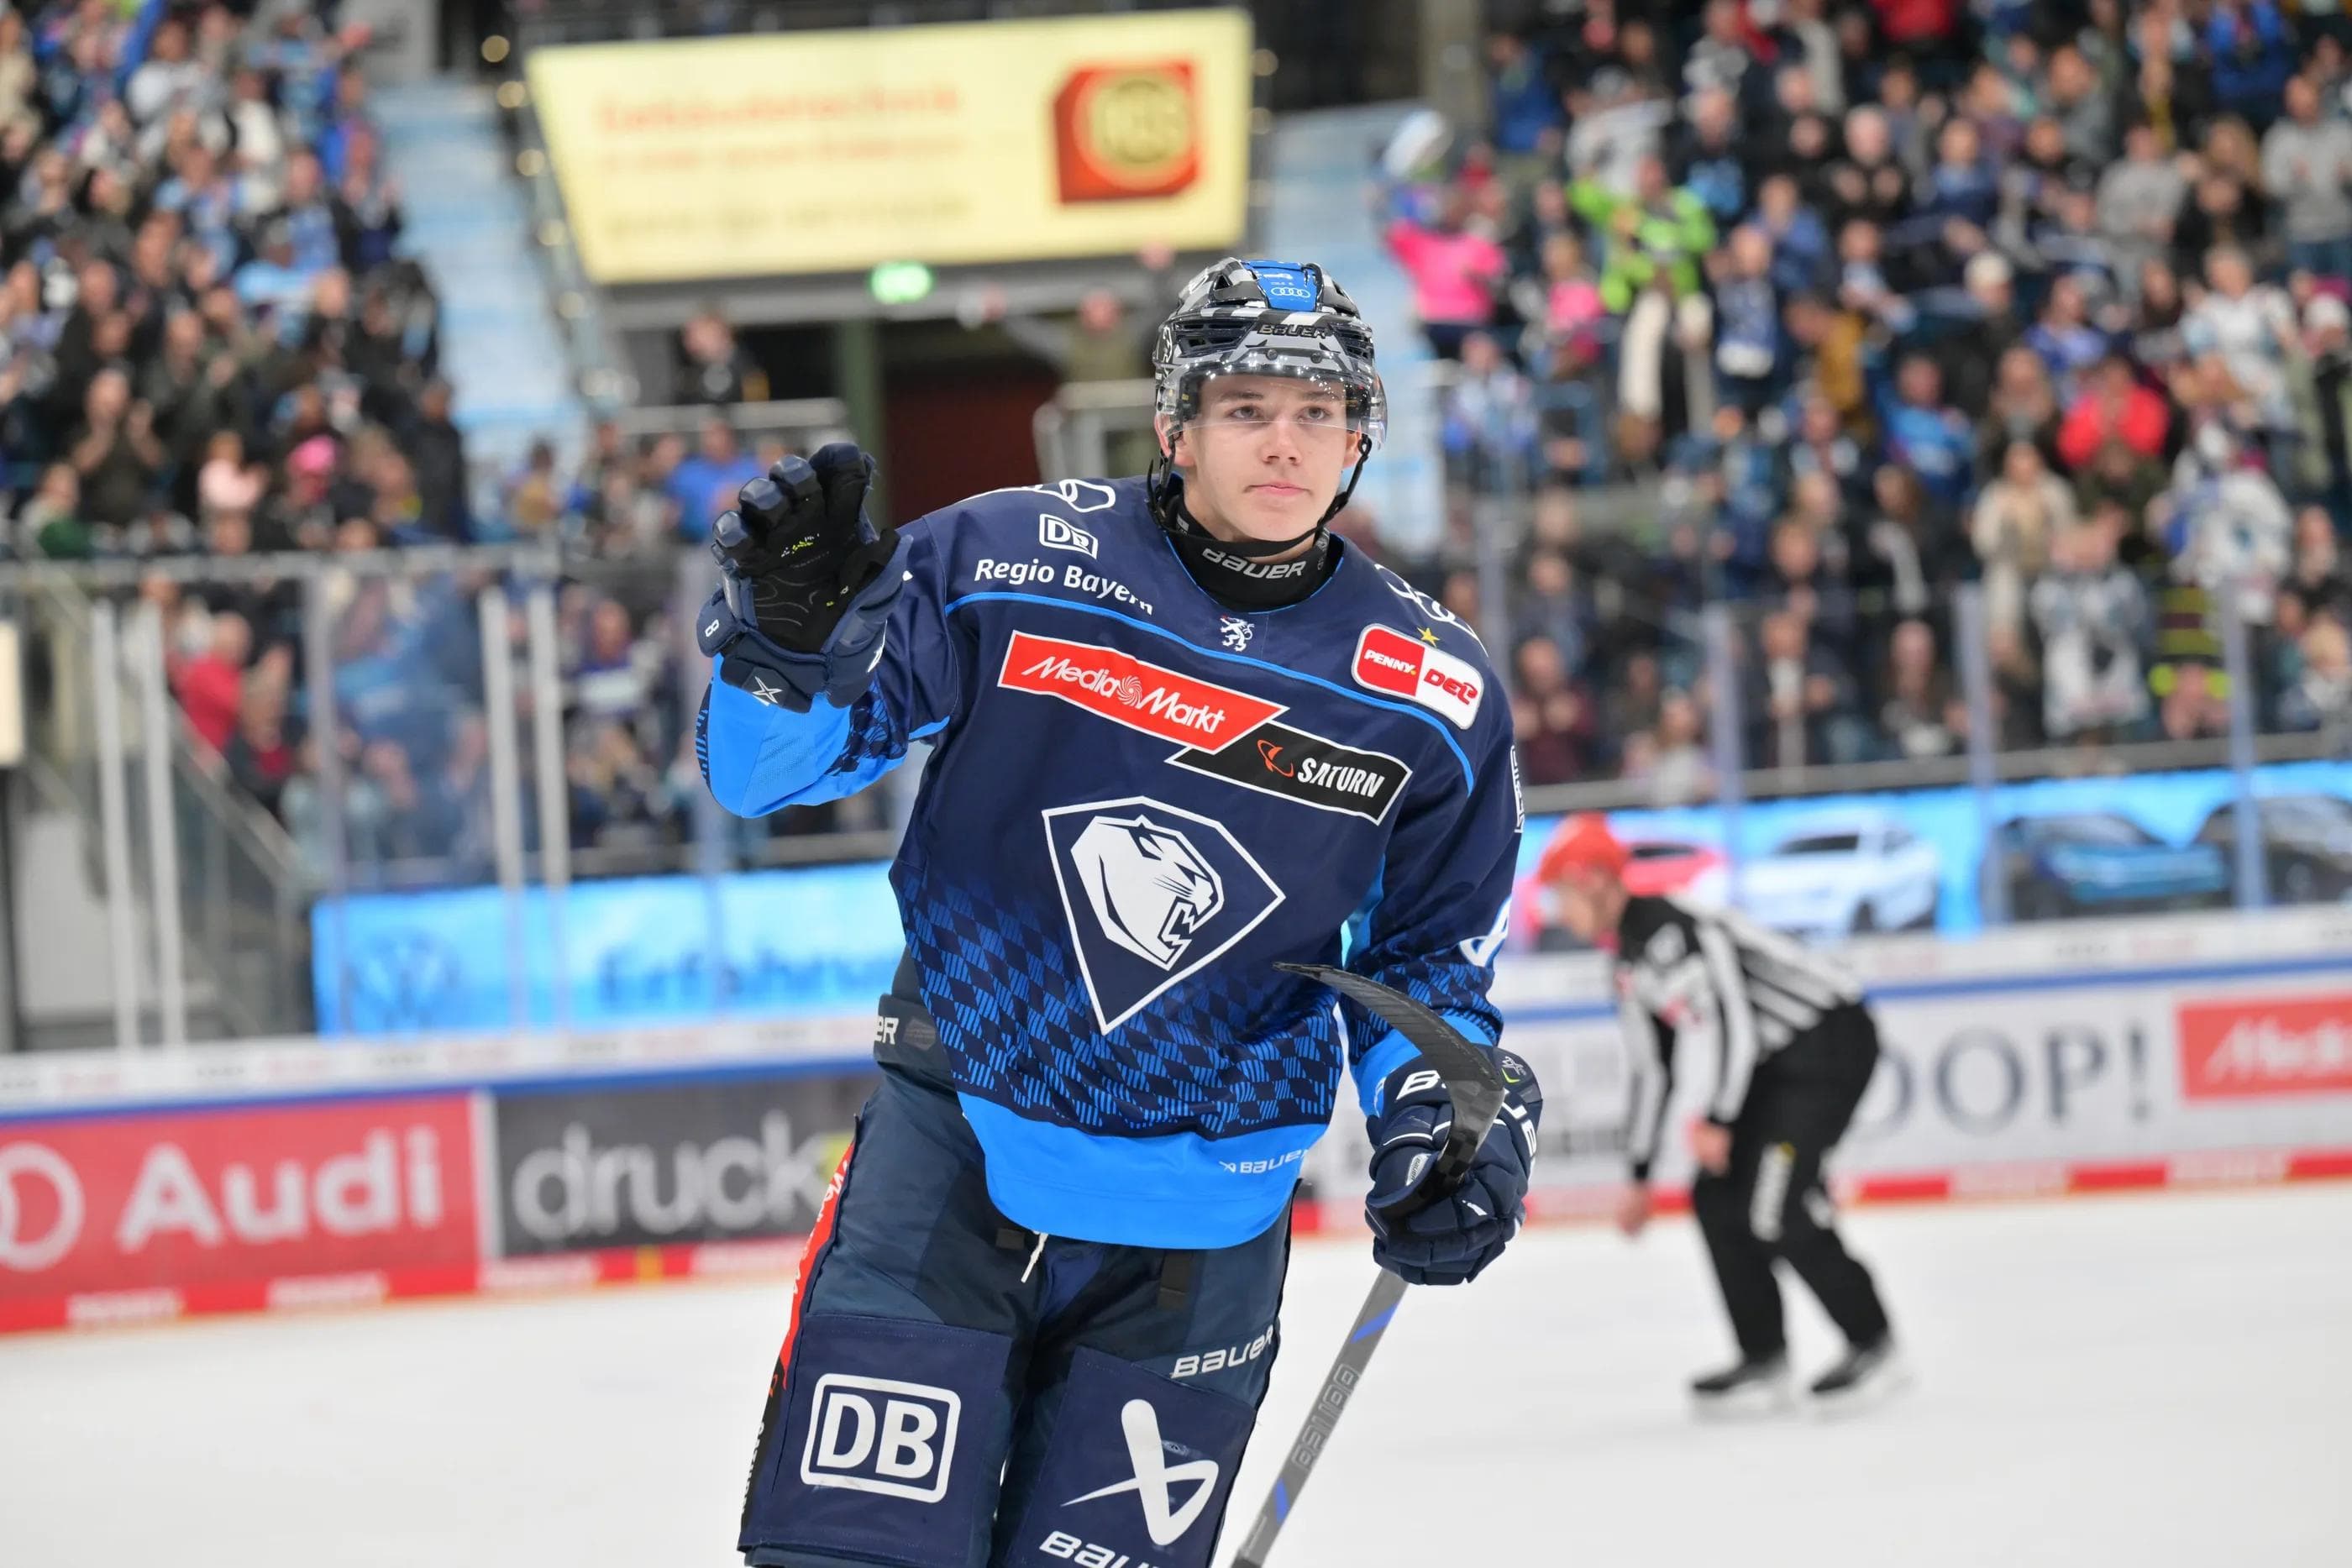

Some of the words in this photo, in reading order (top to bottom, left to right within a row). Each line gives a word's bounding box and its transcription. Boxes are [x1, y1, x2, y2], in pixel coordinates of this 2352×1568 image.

[974, 559, 1054, 585] Regio
[1063, 565, 1153, 616] Bayern
[1202, 548, 1306, 579] BAUER
[1297, 757, 1385, 798] SATURN
[115, 1125, 443, 1253] Audi
[1170, 1324, 1274, 1378] BAUER
[816, 1393, 939, 1481] DB
